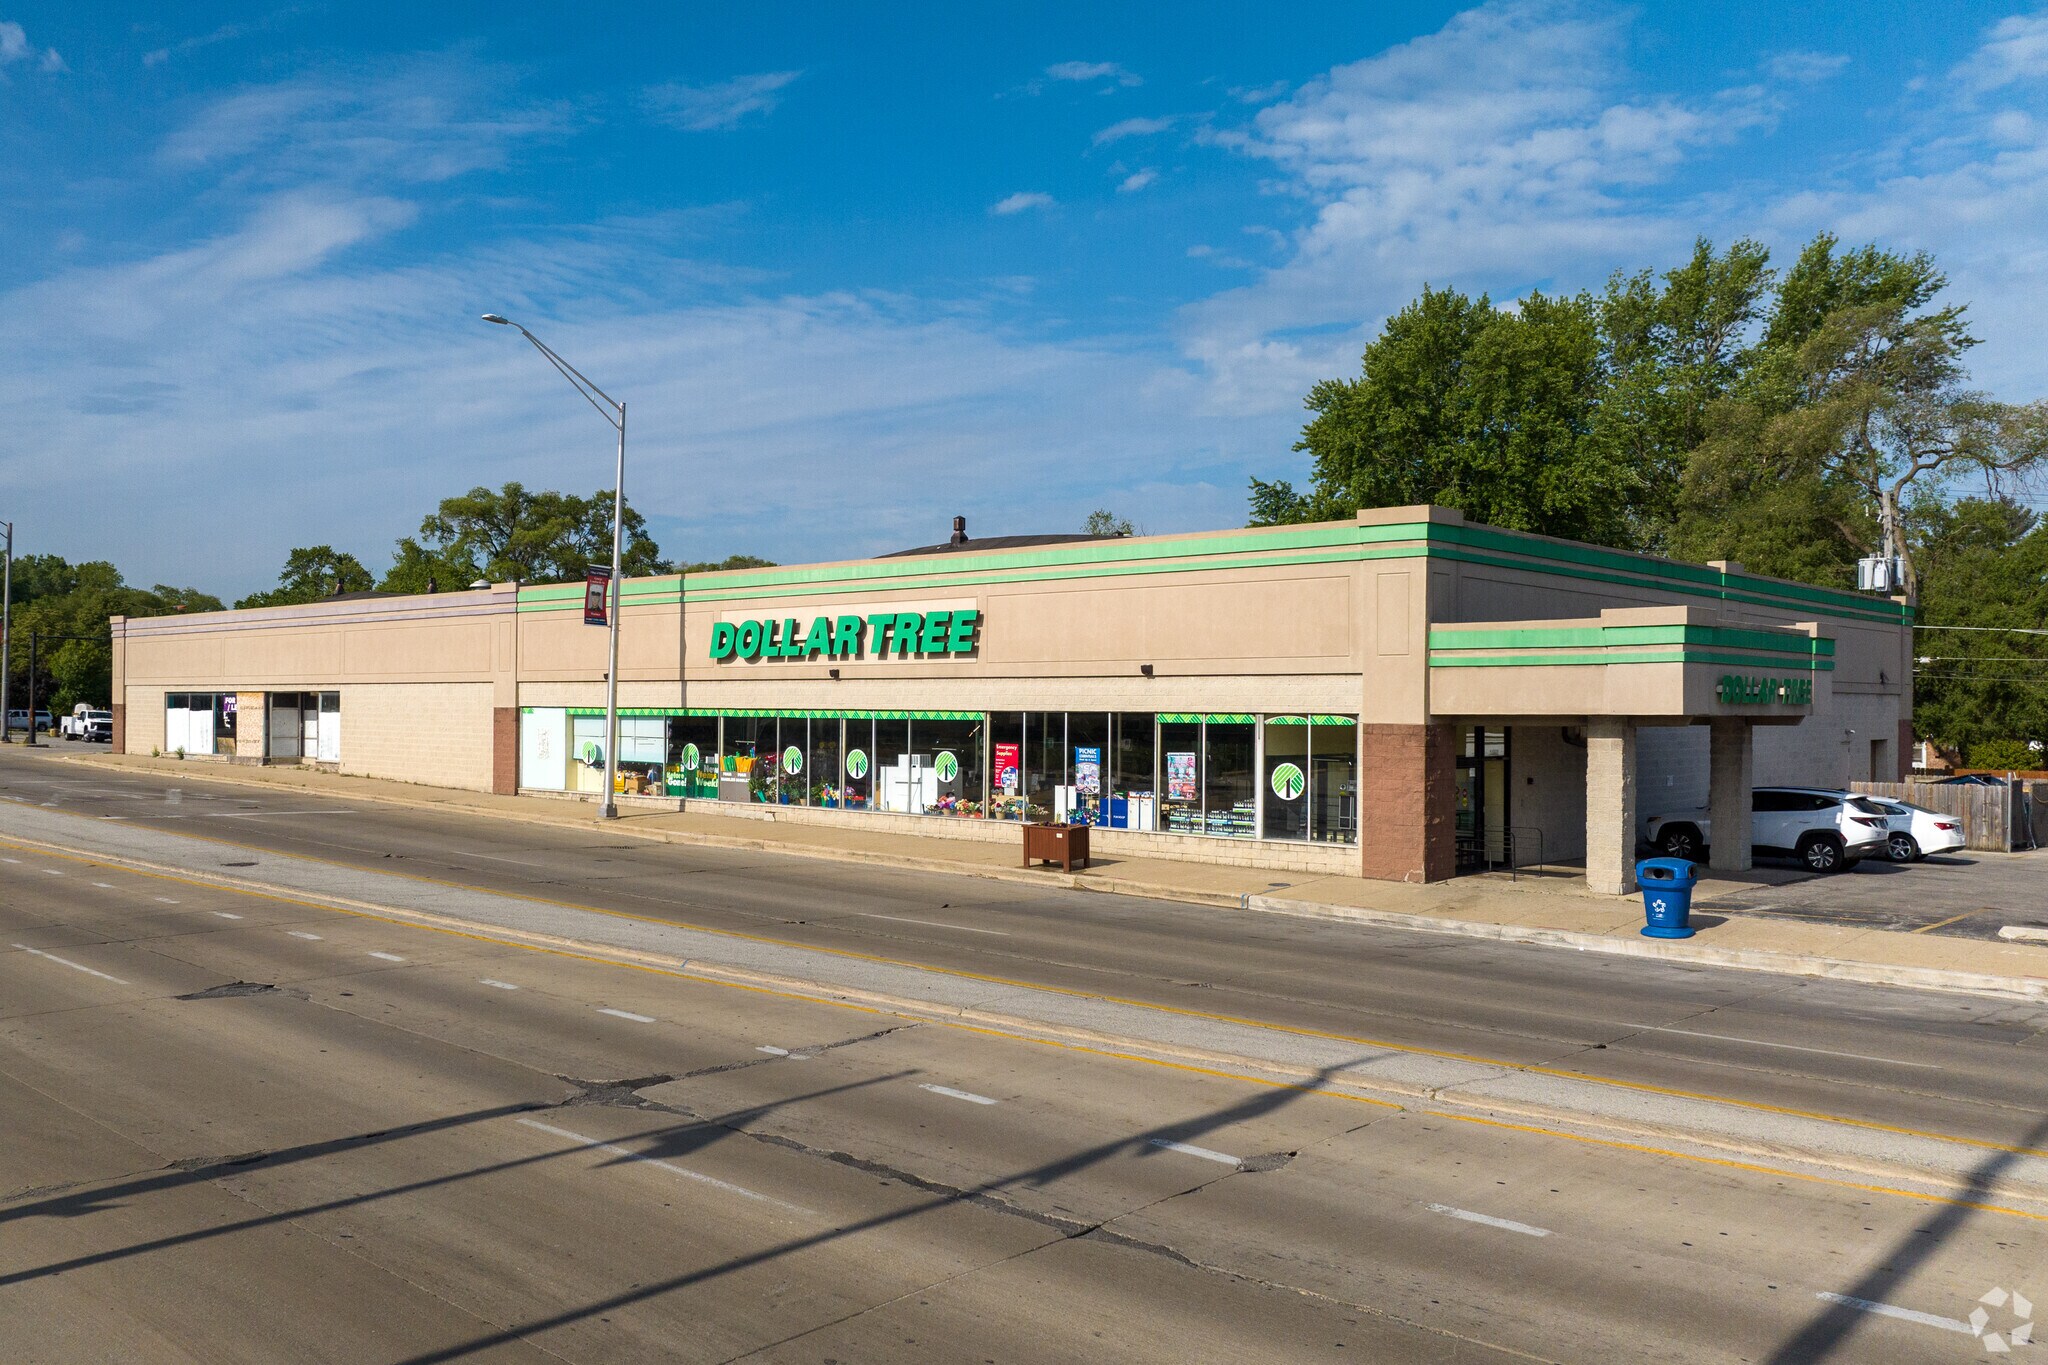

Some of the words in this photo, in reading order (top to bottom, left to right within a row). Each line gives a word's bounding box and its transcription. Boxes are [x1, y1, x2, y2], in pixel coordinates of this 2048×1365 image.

[709, 615, 862, 659] DOLLAR
[867, 609, 980, 654] TREE
[1721, 675, 1776, 704] DOLLAR
[1782, 678, 1811, 704] TREE
